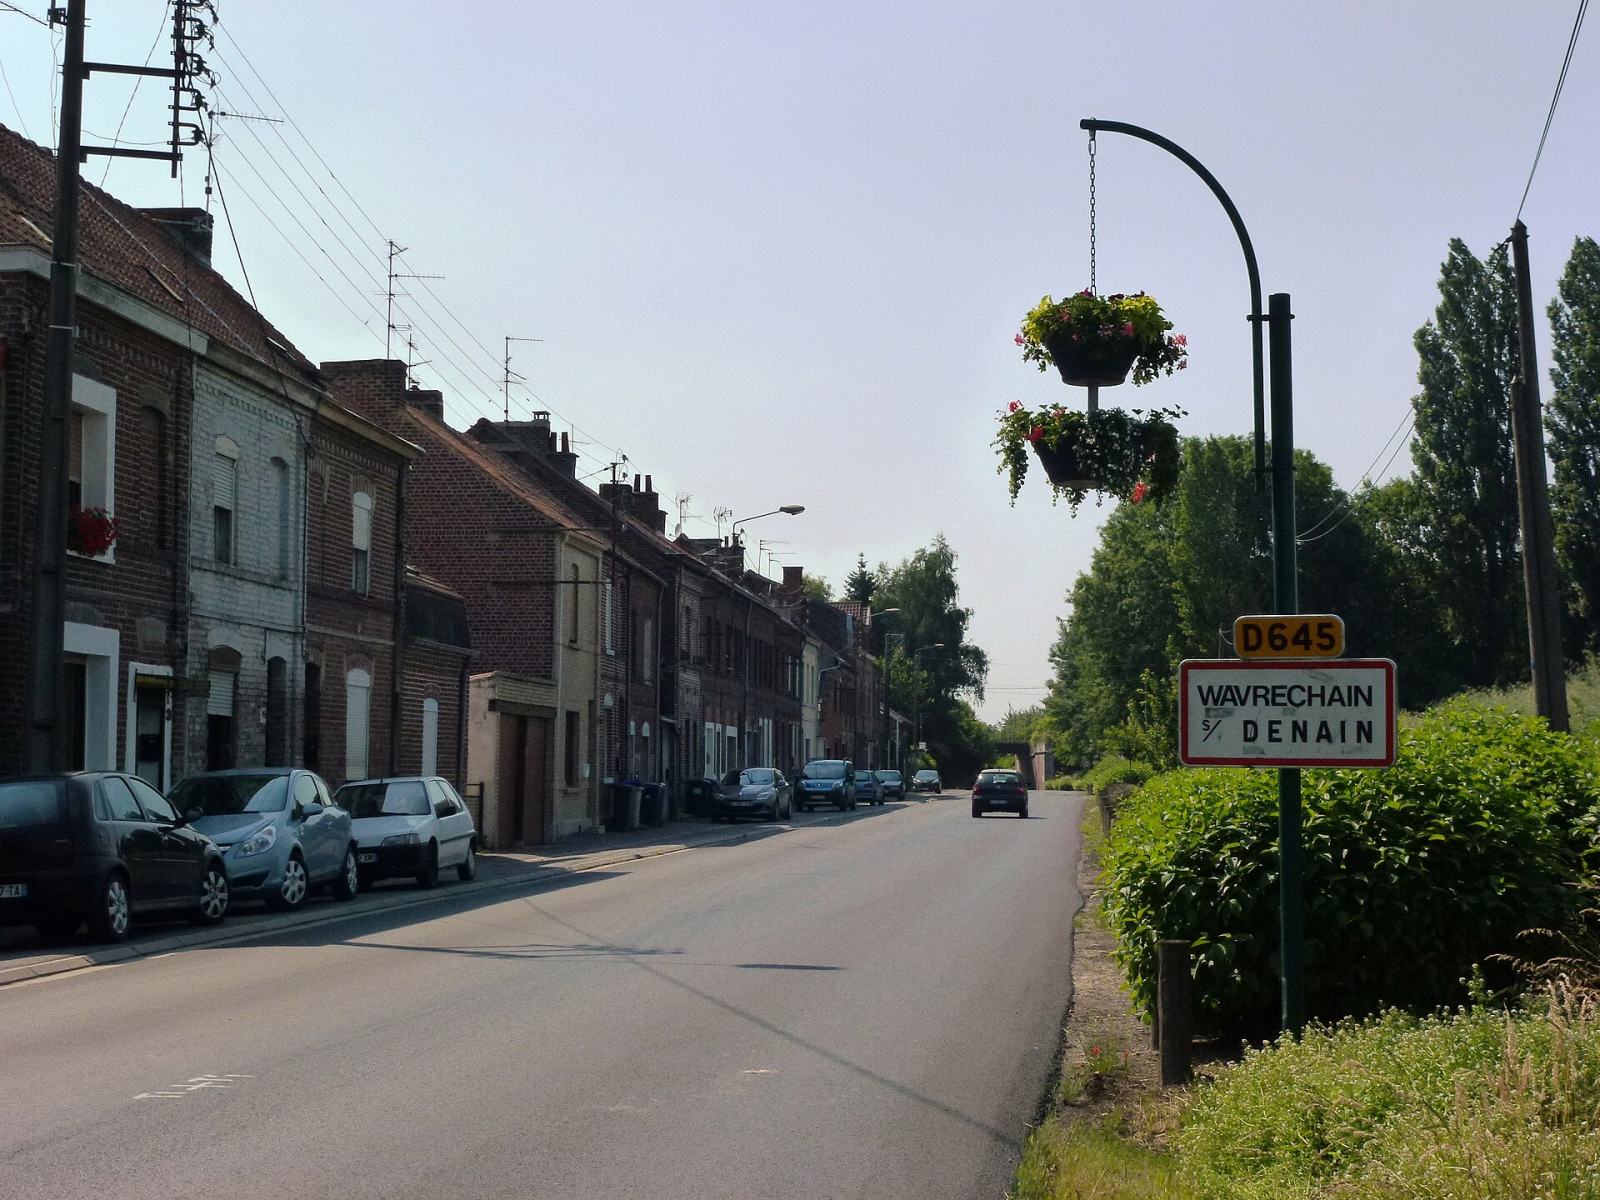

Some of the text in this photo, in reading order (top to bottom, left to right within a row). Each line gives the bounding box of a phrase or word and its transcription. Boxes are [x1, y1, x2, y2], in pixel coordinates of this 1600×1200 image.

[1242, 622, 1336, 651] D645
[1197, 684, 1373, 708] WAVRECHAIN
[1243, 719, 1373, 744] DENAIN
